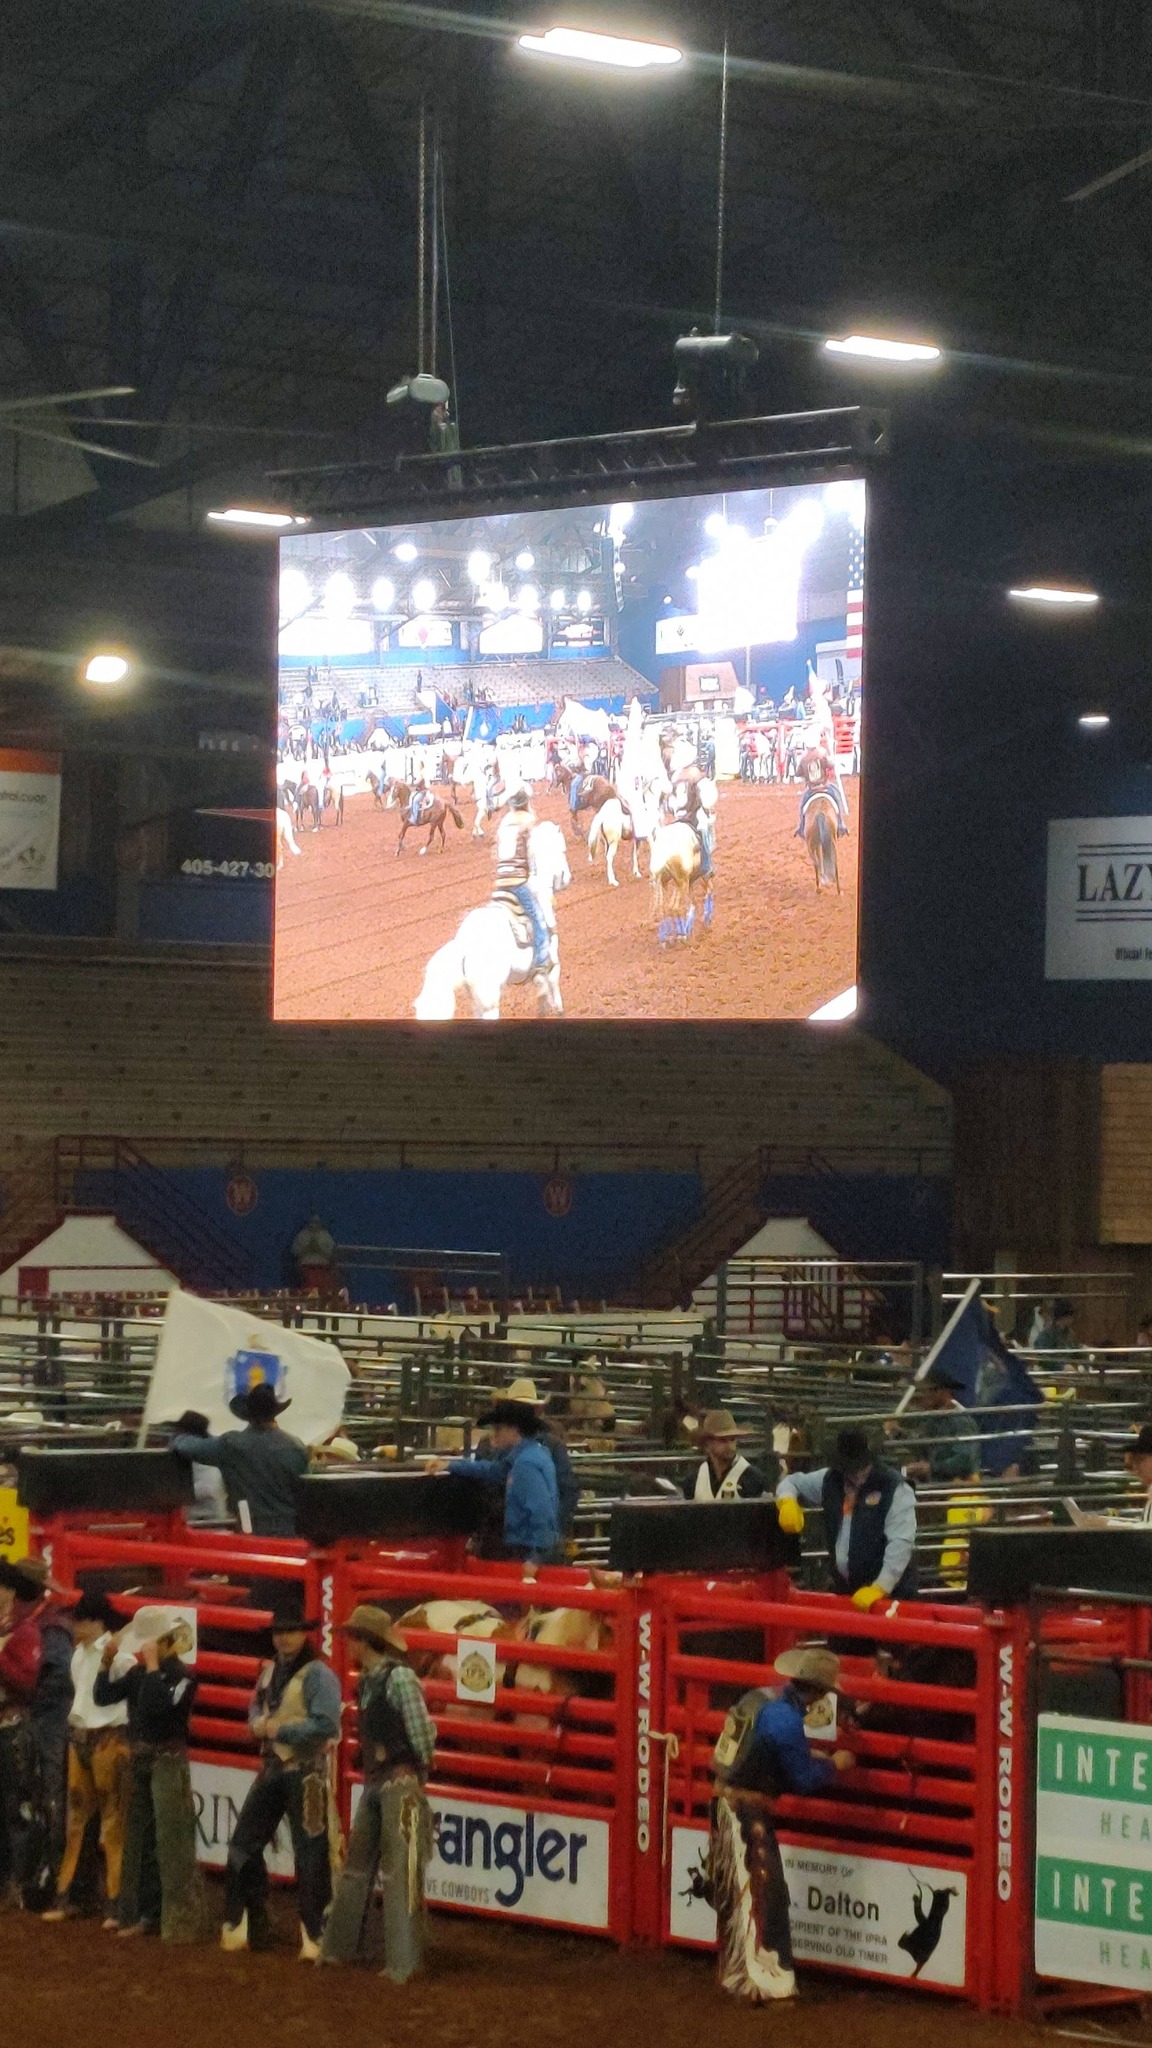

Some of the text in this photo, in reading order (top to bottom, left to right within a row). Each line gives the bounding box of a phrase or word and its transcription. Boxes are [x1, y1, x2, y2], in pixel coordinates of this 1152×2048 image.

[637, 1612, 651, 1852] W-W RODEO
[998, 1645, 1013, 1901] W-W RODEO
[1055, 1743, 1148, 1792] INTE
[797, 1860, 838, 1875] MEMORY
[841, 1865, 854, 1878] OF
[441, 1880, 490, 1904] COWBOYS
[807, 1885, 880, 1921] Dalton
[1053, 1870, 1145, 1921] INTE
[827, 1926, 840, 1938] OF
[844, 1928, 863, 1941] THE
[835, 1945, 856, 1959] OLD
[859, 1949, 888, 1965] TIMER
